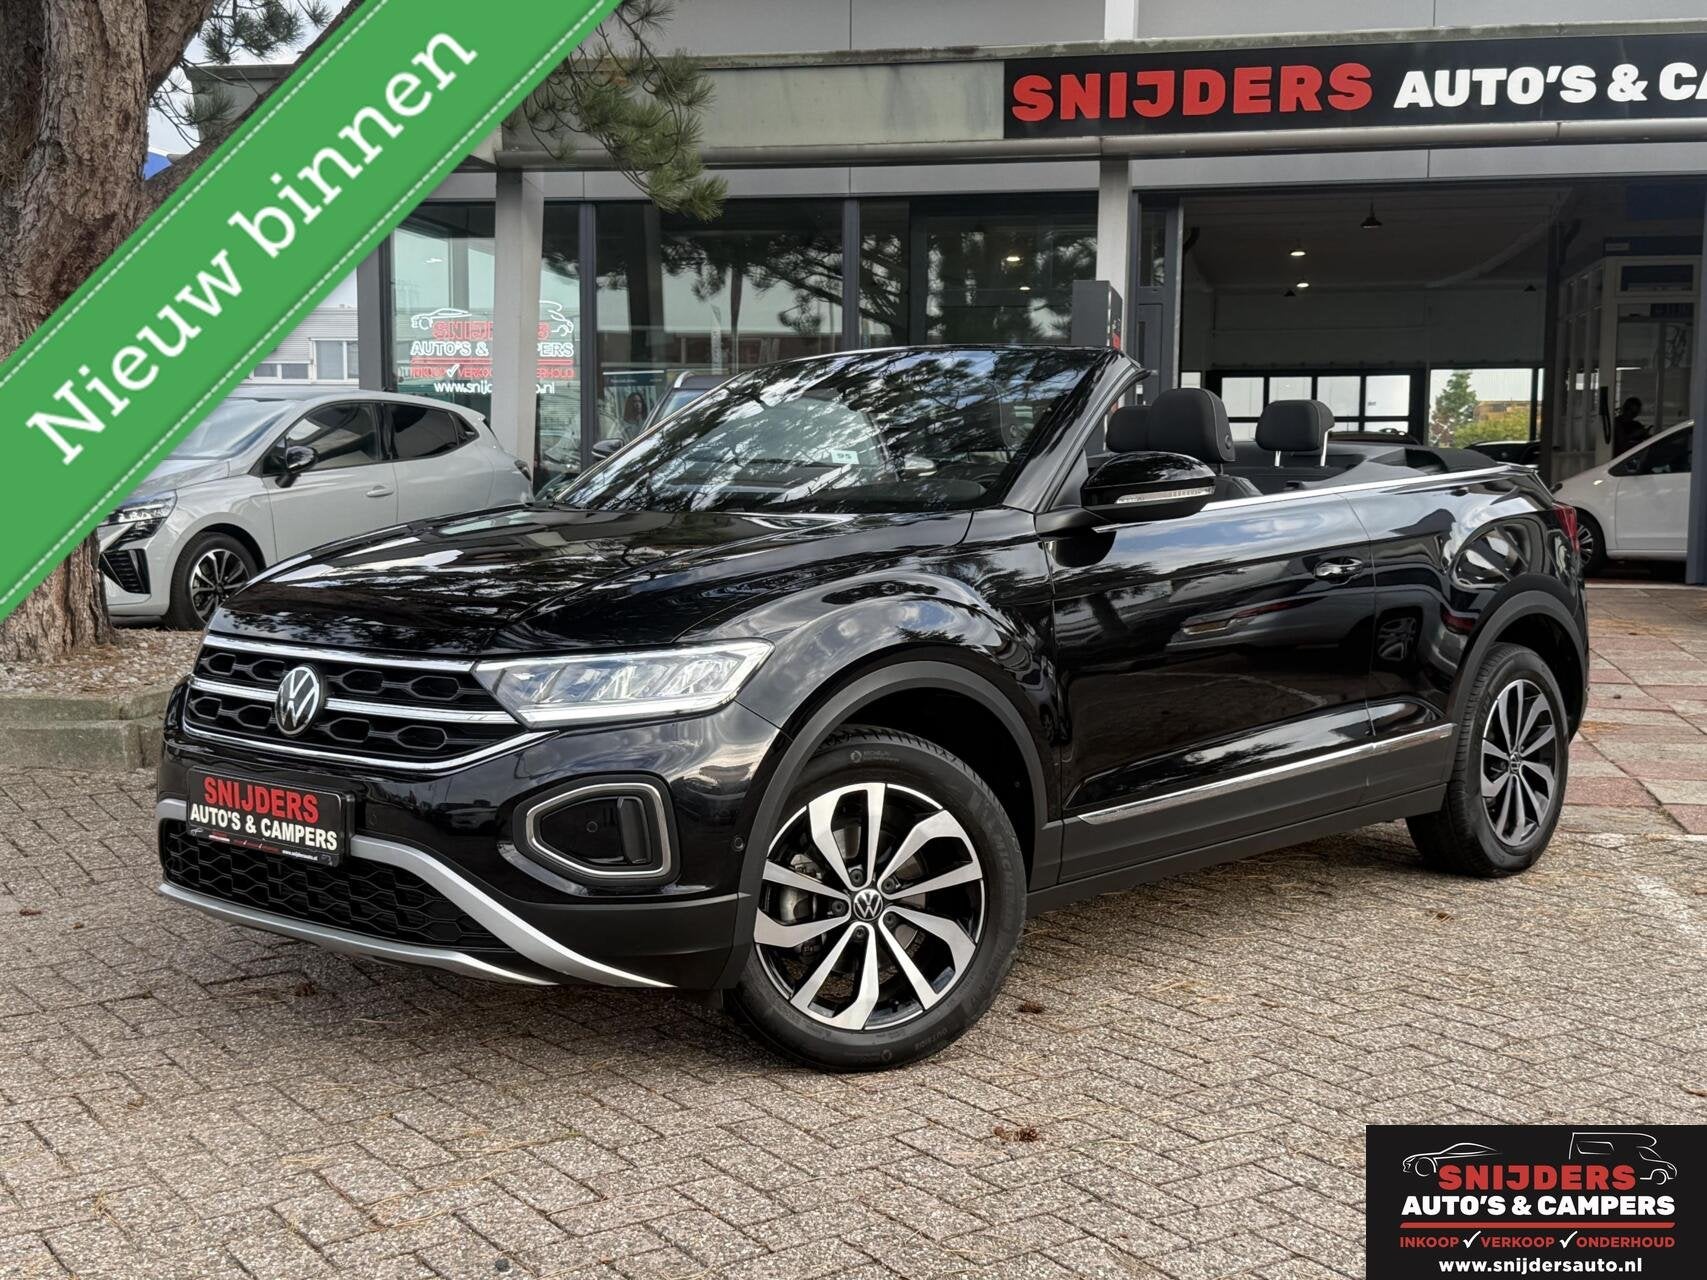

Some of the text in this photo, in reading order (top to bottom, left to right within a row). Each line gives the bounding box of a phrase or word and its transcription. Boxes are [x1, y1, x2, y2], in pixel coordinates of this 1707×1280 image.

[1012, 63, 1373, 122] SNIJDERS
[1394, 65, 1597, 109] AUTO'S
[1607, 63, 1648, 102] &
[410, 341, 490, 357] AUTO'S &
[204, 776, 319, 824] SNIJDERS
[190, 803, 242, 831] AUTO'S
[245, 814, 257, 834] &
[260, 818, 338, 851] CAMPERS
